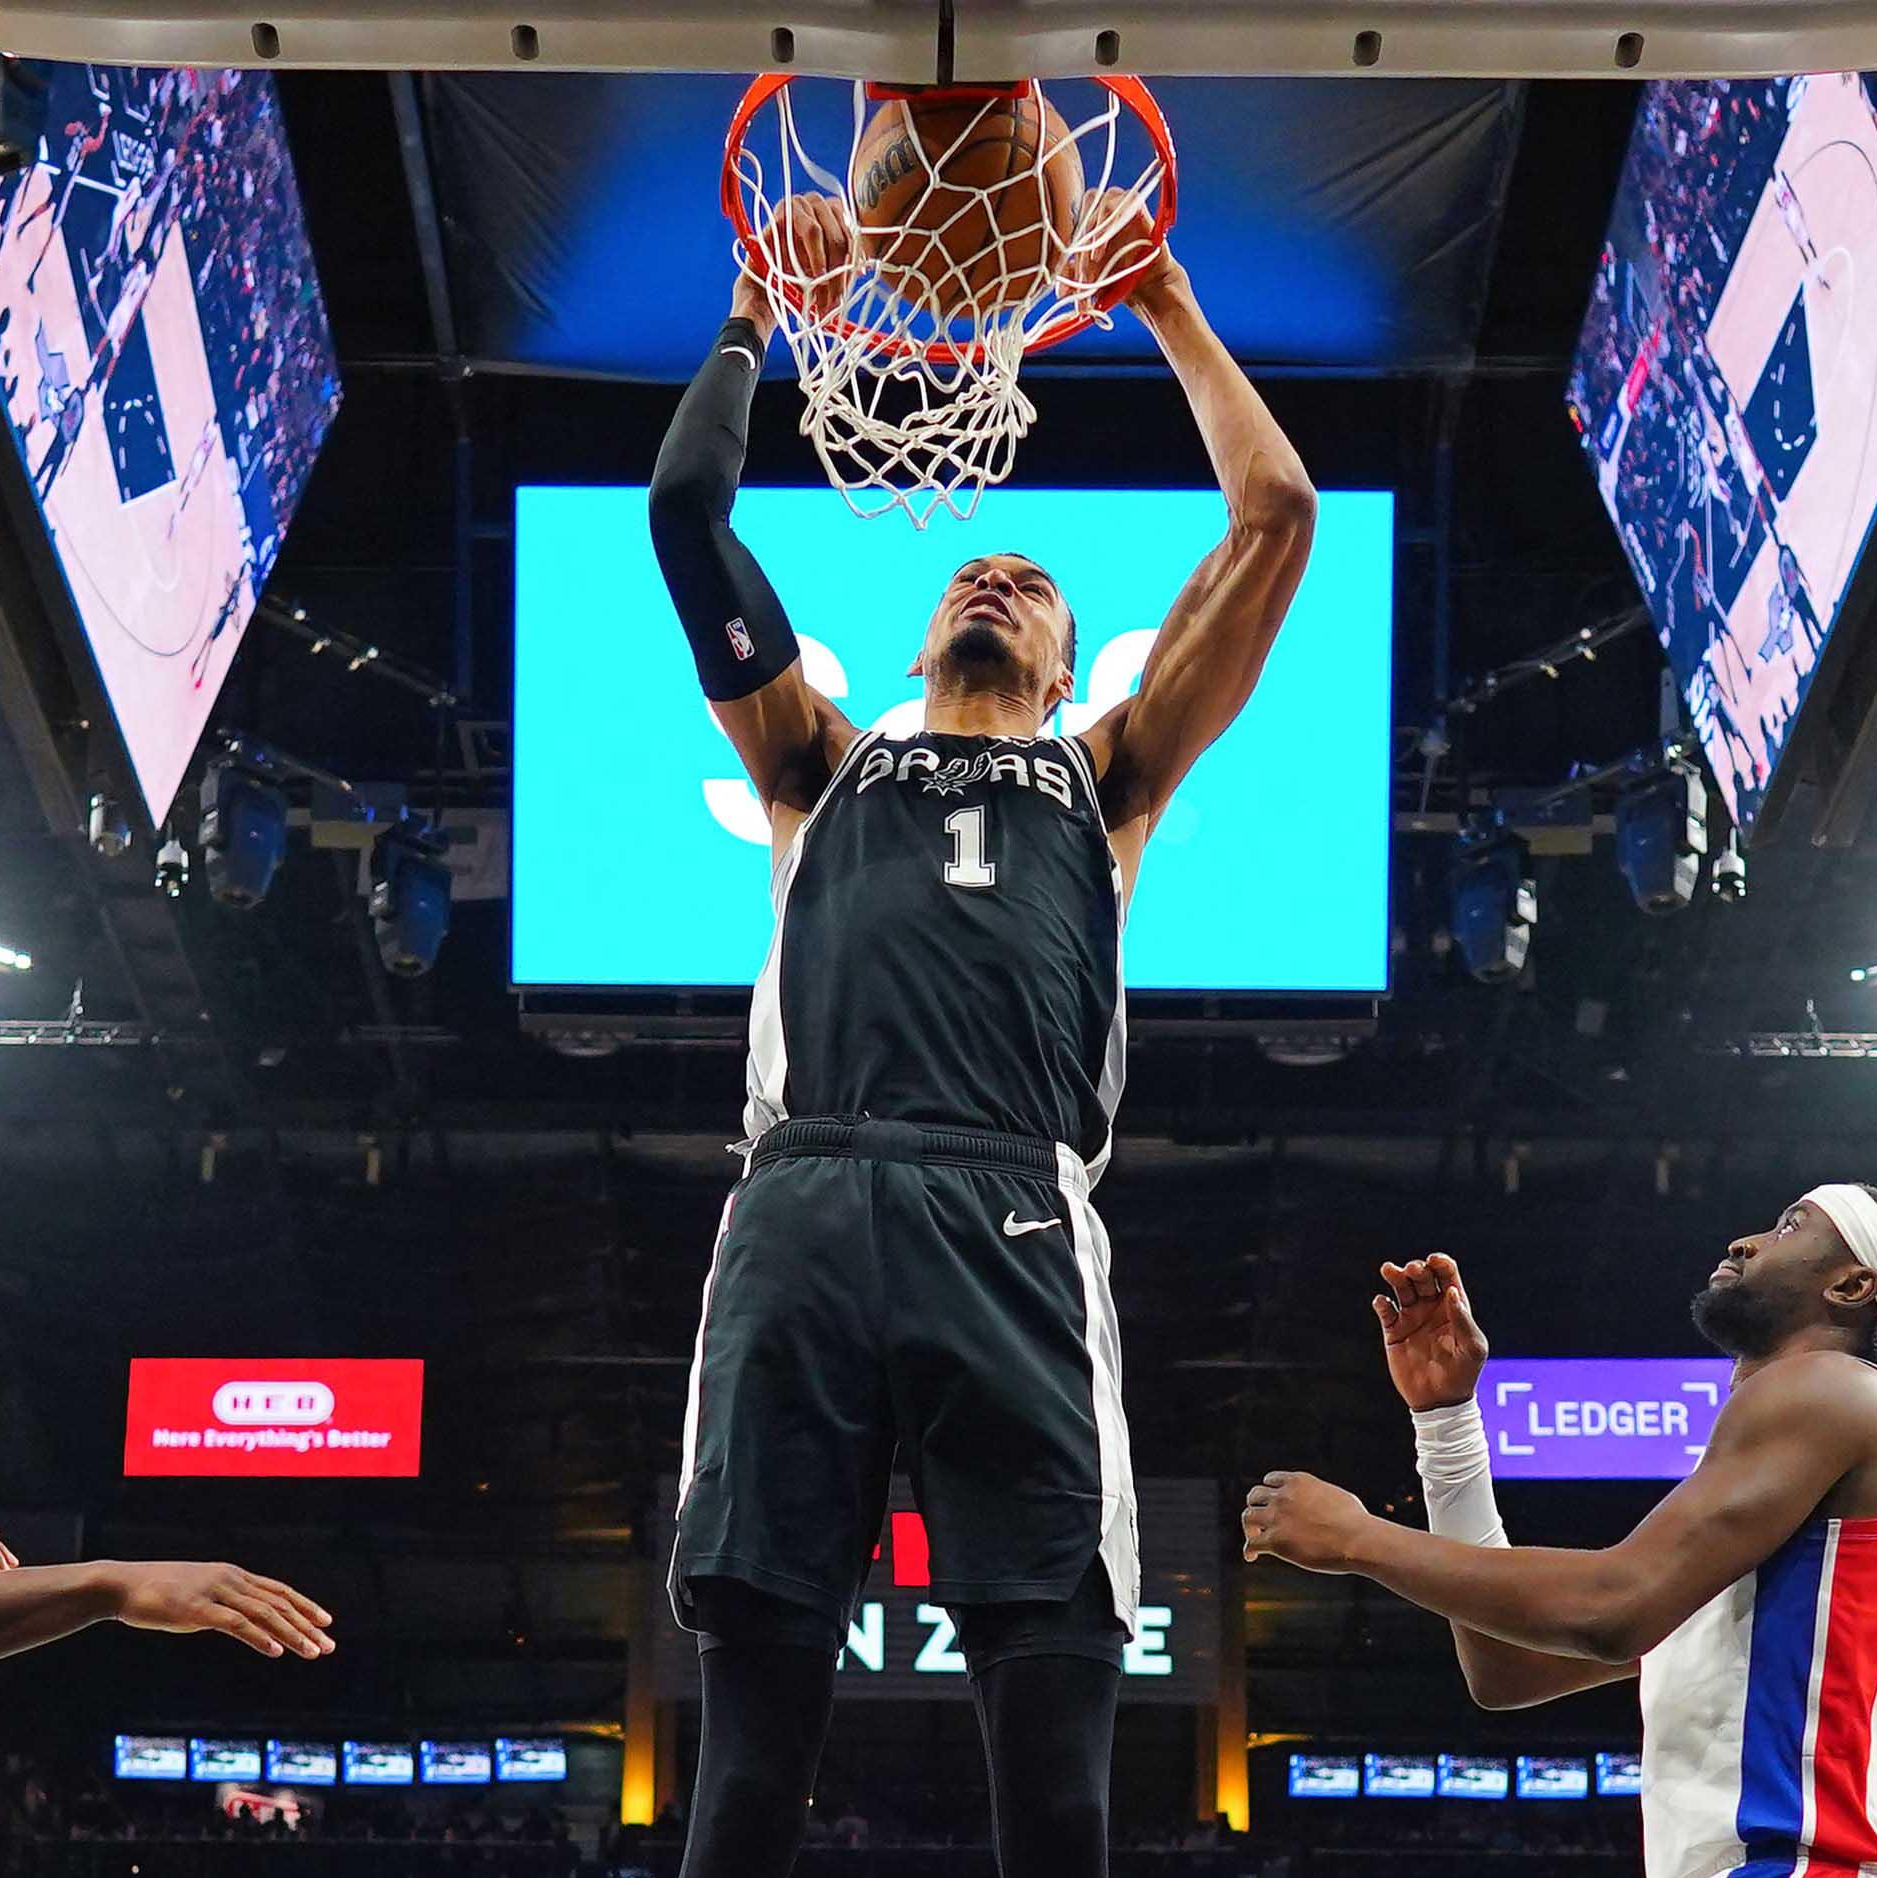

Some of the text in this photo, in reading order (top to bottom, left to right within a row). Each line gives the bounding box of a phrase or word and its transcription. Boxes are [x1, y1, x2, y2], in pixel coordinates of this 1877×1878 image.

[944, 806, 995, 887] 1
[152, 1427, 392, 1453] Here Everything's Better
[1526, 1401, 1691, 1438] LEDGER
[915, 1602, 1174, 1674] ZE
